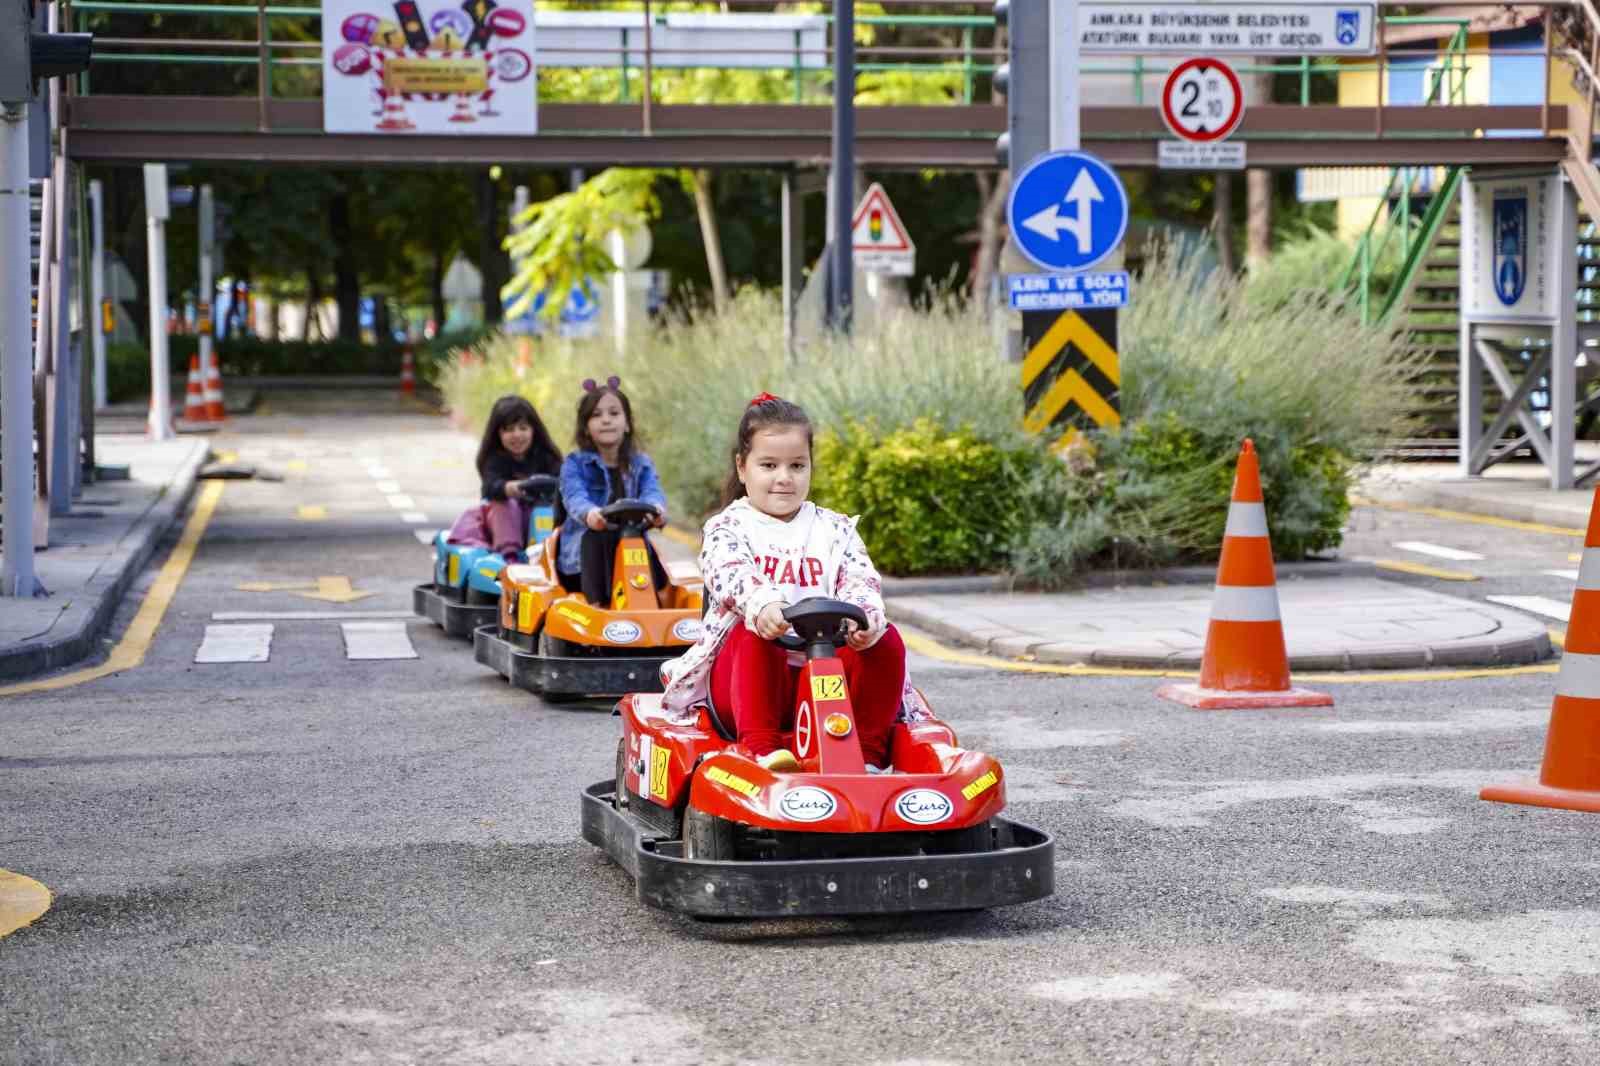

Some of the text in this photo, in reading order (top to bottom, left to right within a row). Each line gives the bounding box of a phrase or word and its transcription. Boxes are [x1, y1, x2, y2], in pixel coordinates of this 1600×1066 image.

[1089, 14, 1143, 25] ANKARA
[1181, 80, 1200, 117] 2
[1057, 276, 1078, 290] VE
[1084, 274, 1124, 288] SOLA
[814, 676, 844, 699] 12
[650, 747, 668, 796] 12
[783, 791, 831, 810] Euro
[901, 794, 947, 814] Euro
